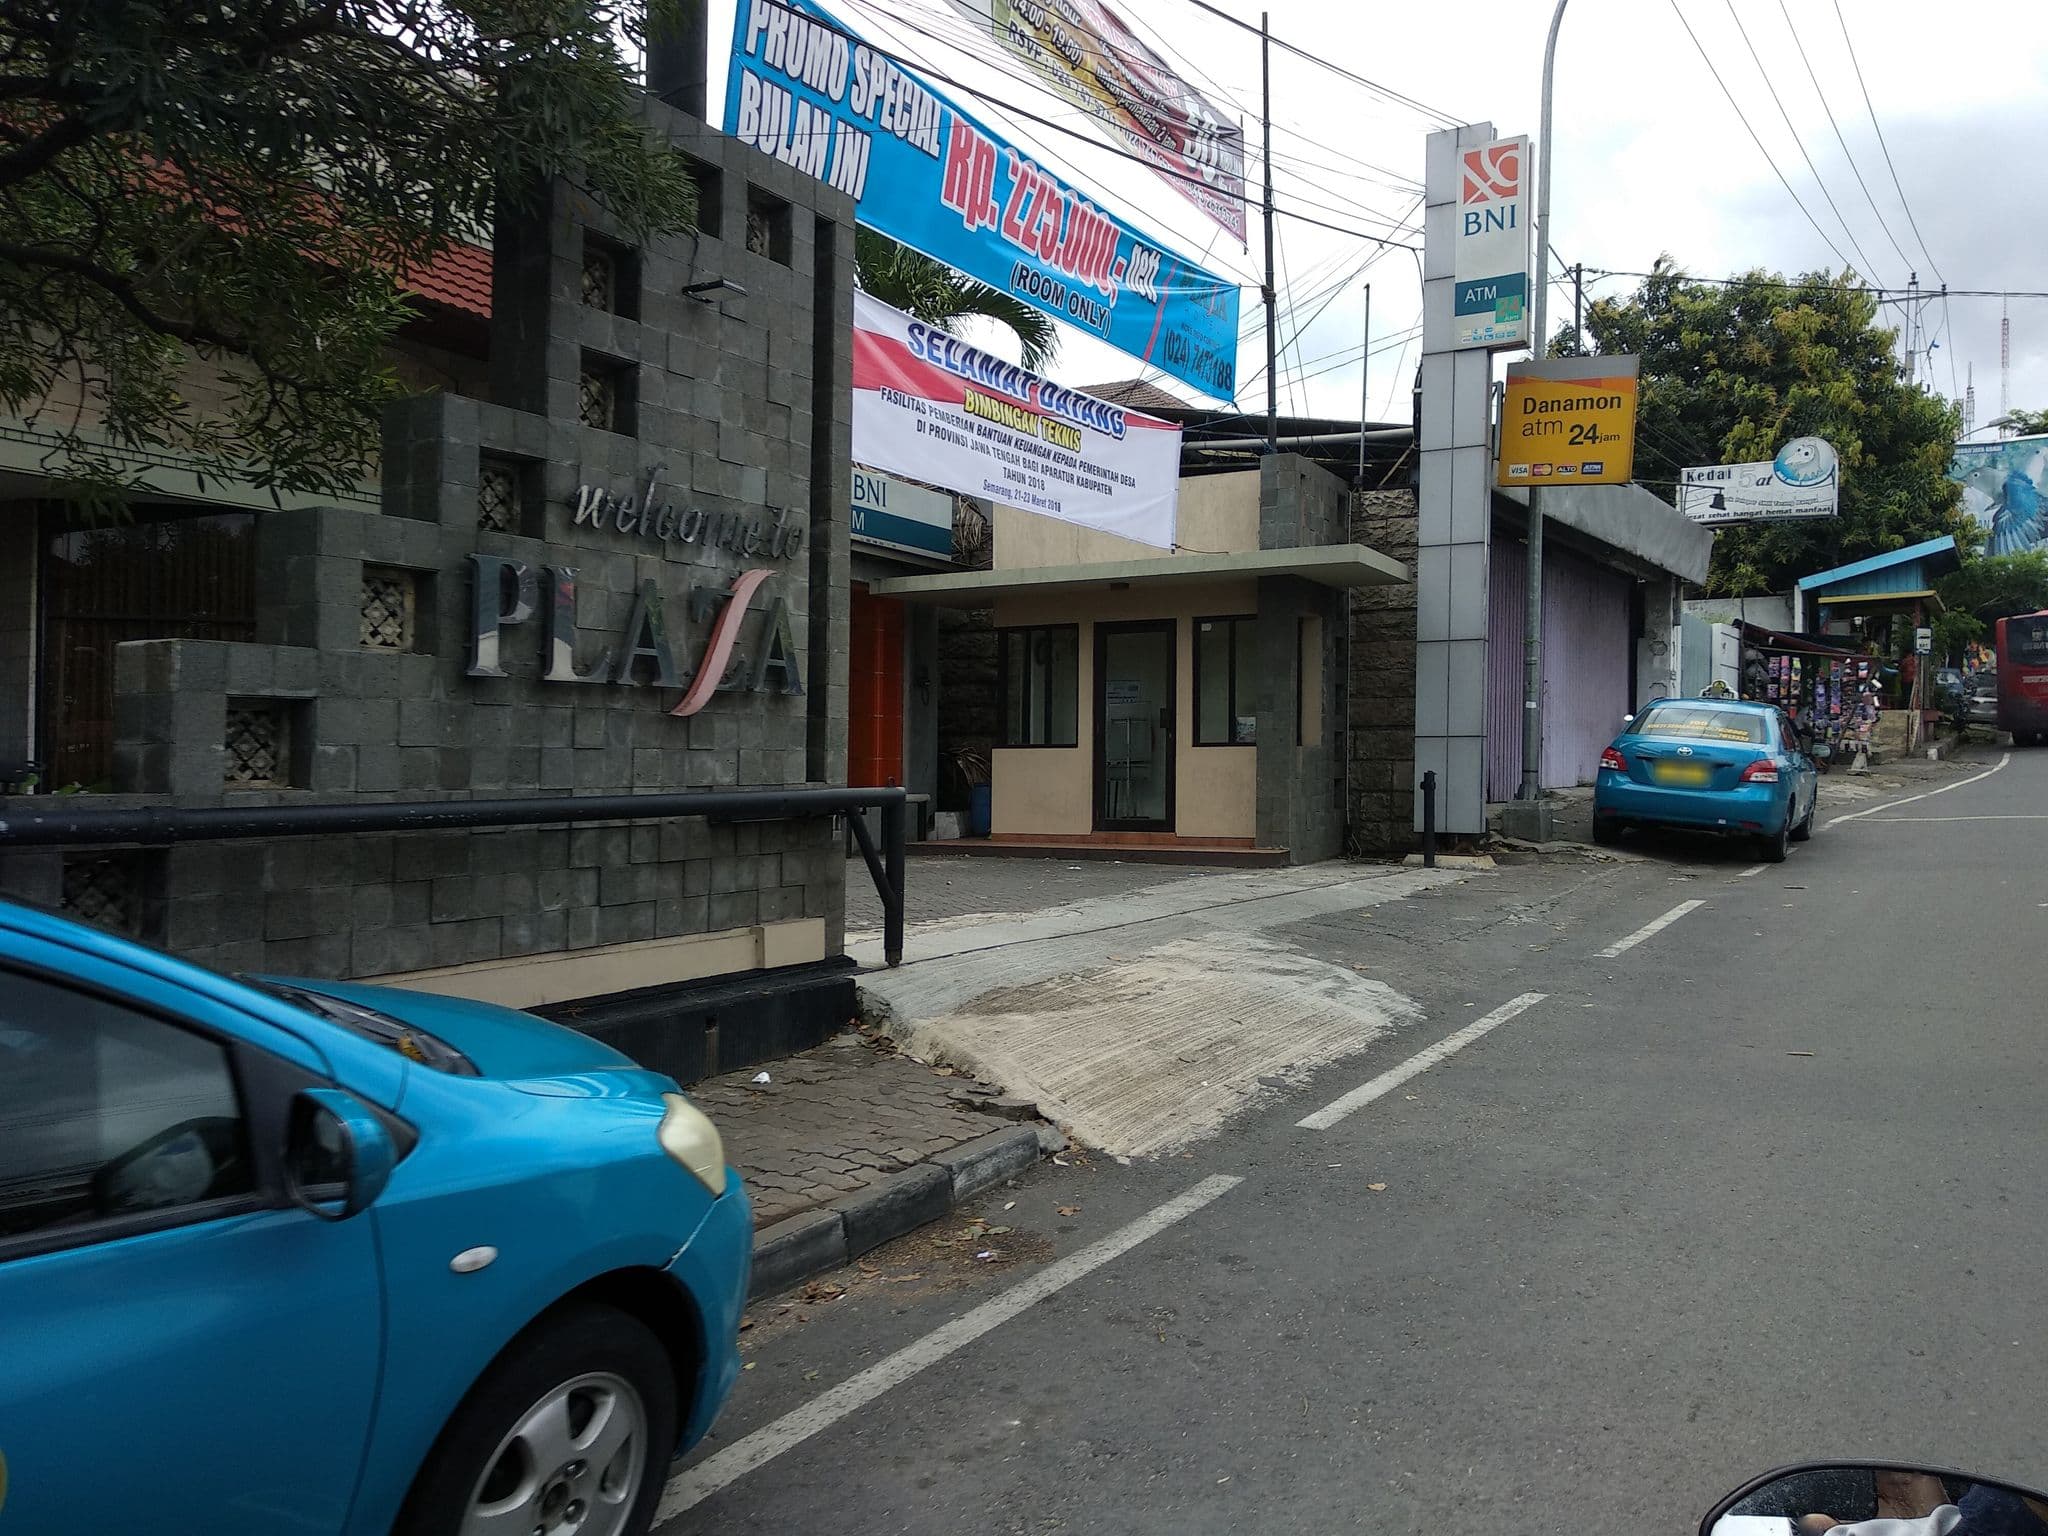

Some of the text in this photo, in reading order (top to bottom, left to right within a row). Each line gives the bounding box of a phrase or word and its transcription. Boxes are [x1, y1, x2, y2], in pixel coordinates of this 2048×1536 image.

[745, 0, 850, 102] PROMO
[851, 43, 942, 161] SPECIAL
[736, 68, 872, 203] BULAN INI
[1463, 204, 1517, 237] BNI
[1010, 261, 1112, 338] (ROOM ONLY)
[1464, 284, 1497, 304] ATM
[906, 322, 1126, 439] SELAMAT DATANG
[1523, 395, 1622, 415] Danamon
[881, 387, 1136, 489] FASILITAS PEMBERIAN BANTUAN KEUANGAN KEPADA PEMERINTAH DESA
[964, 388, 1082, 453] BIMBINGAN TEKNIS
[1522, 418, 1621, 446] atm 24 jam
[916, 418, 1113, 497] DI PROVINSI JAWA TENGAH BAGI APARATUR KABUPATEN
[1002, 466, 1046, 492] TAHUN 2018
[1511, 466, 1528, 474] VISA
[853, 473, 887, 508] BNI
[1014, 487, 1031, 503] 21-23
[1031, 492, 1047, 510] Maret
[1047, 498, 1062, 513] 2018
[464, 552, 806, 717] PLAZA
